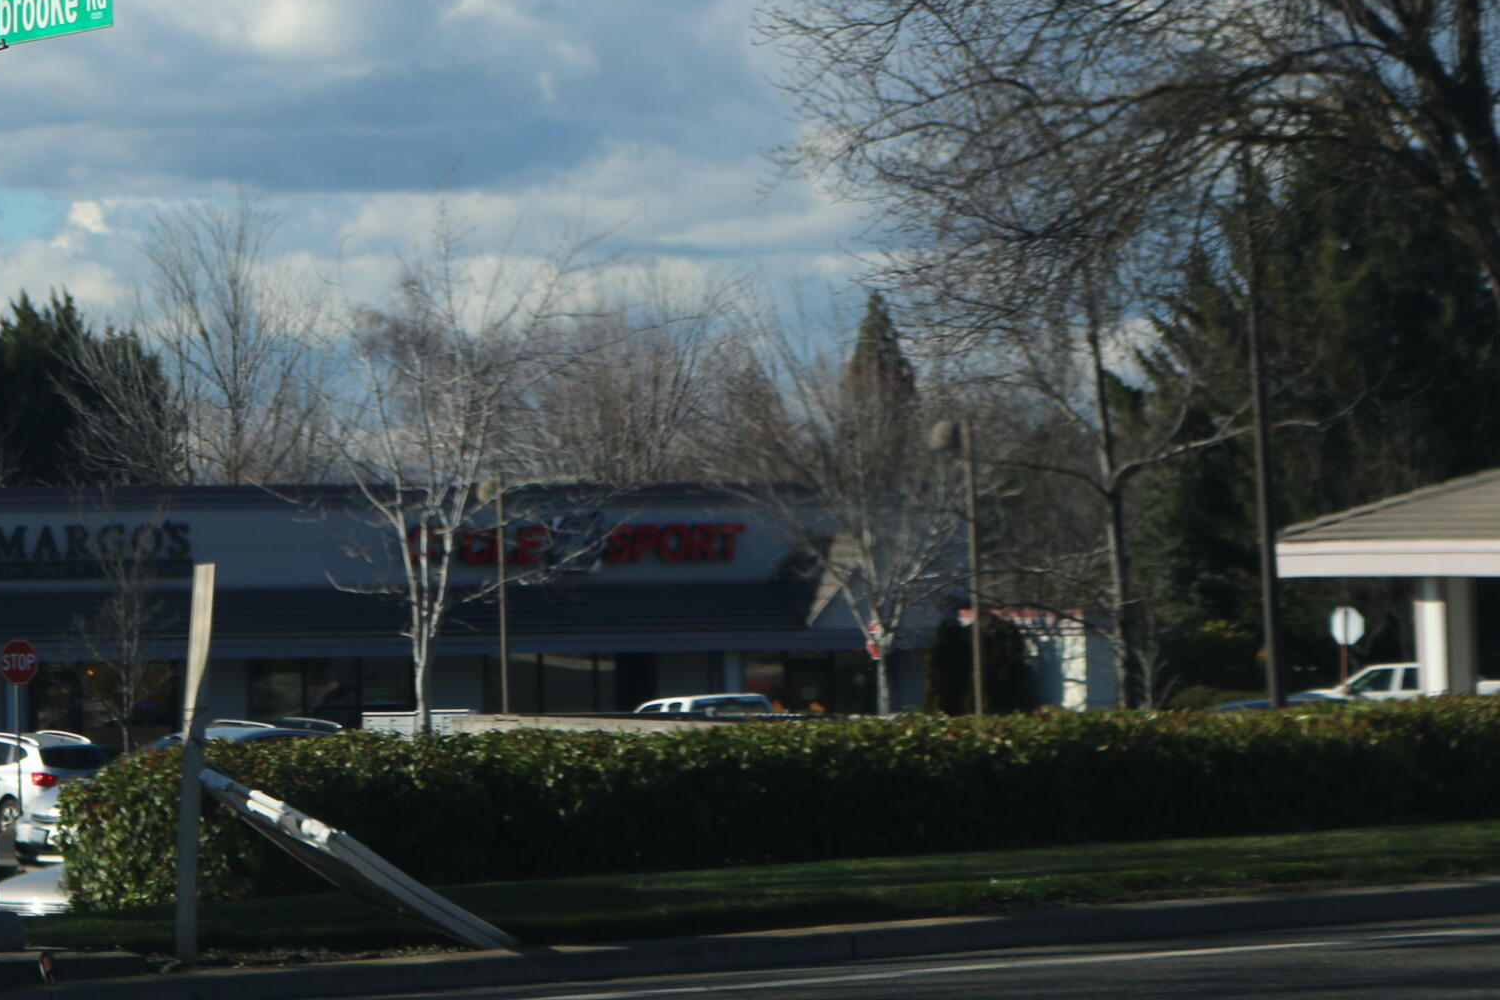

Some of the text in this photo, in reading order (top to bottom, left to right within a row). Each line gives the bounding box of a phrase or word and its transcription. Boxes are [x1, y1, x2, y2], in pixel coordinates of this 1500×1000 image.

[408, 523, 747, 565] CCLE SPORT
[1, 653, 37, 671] STOP
